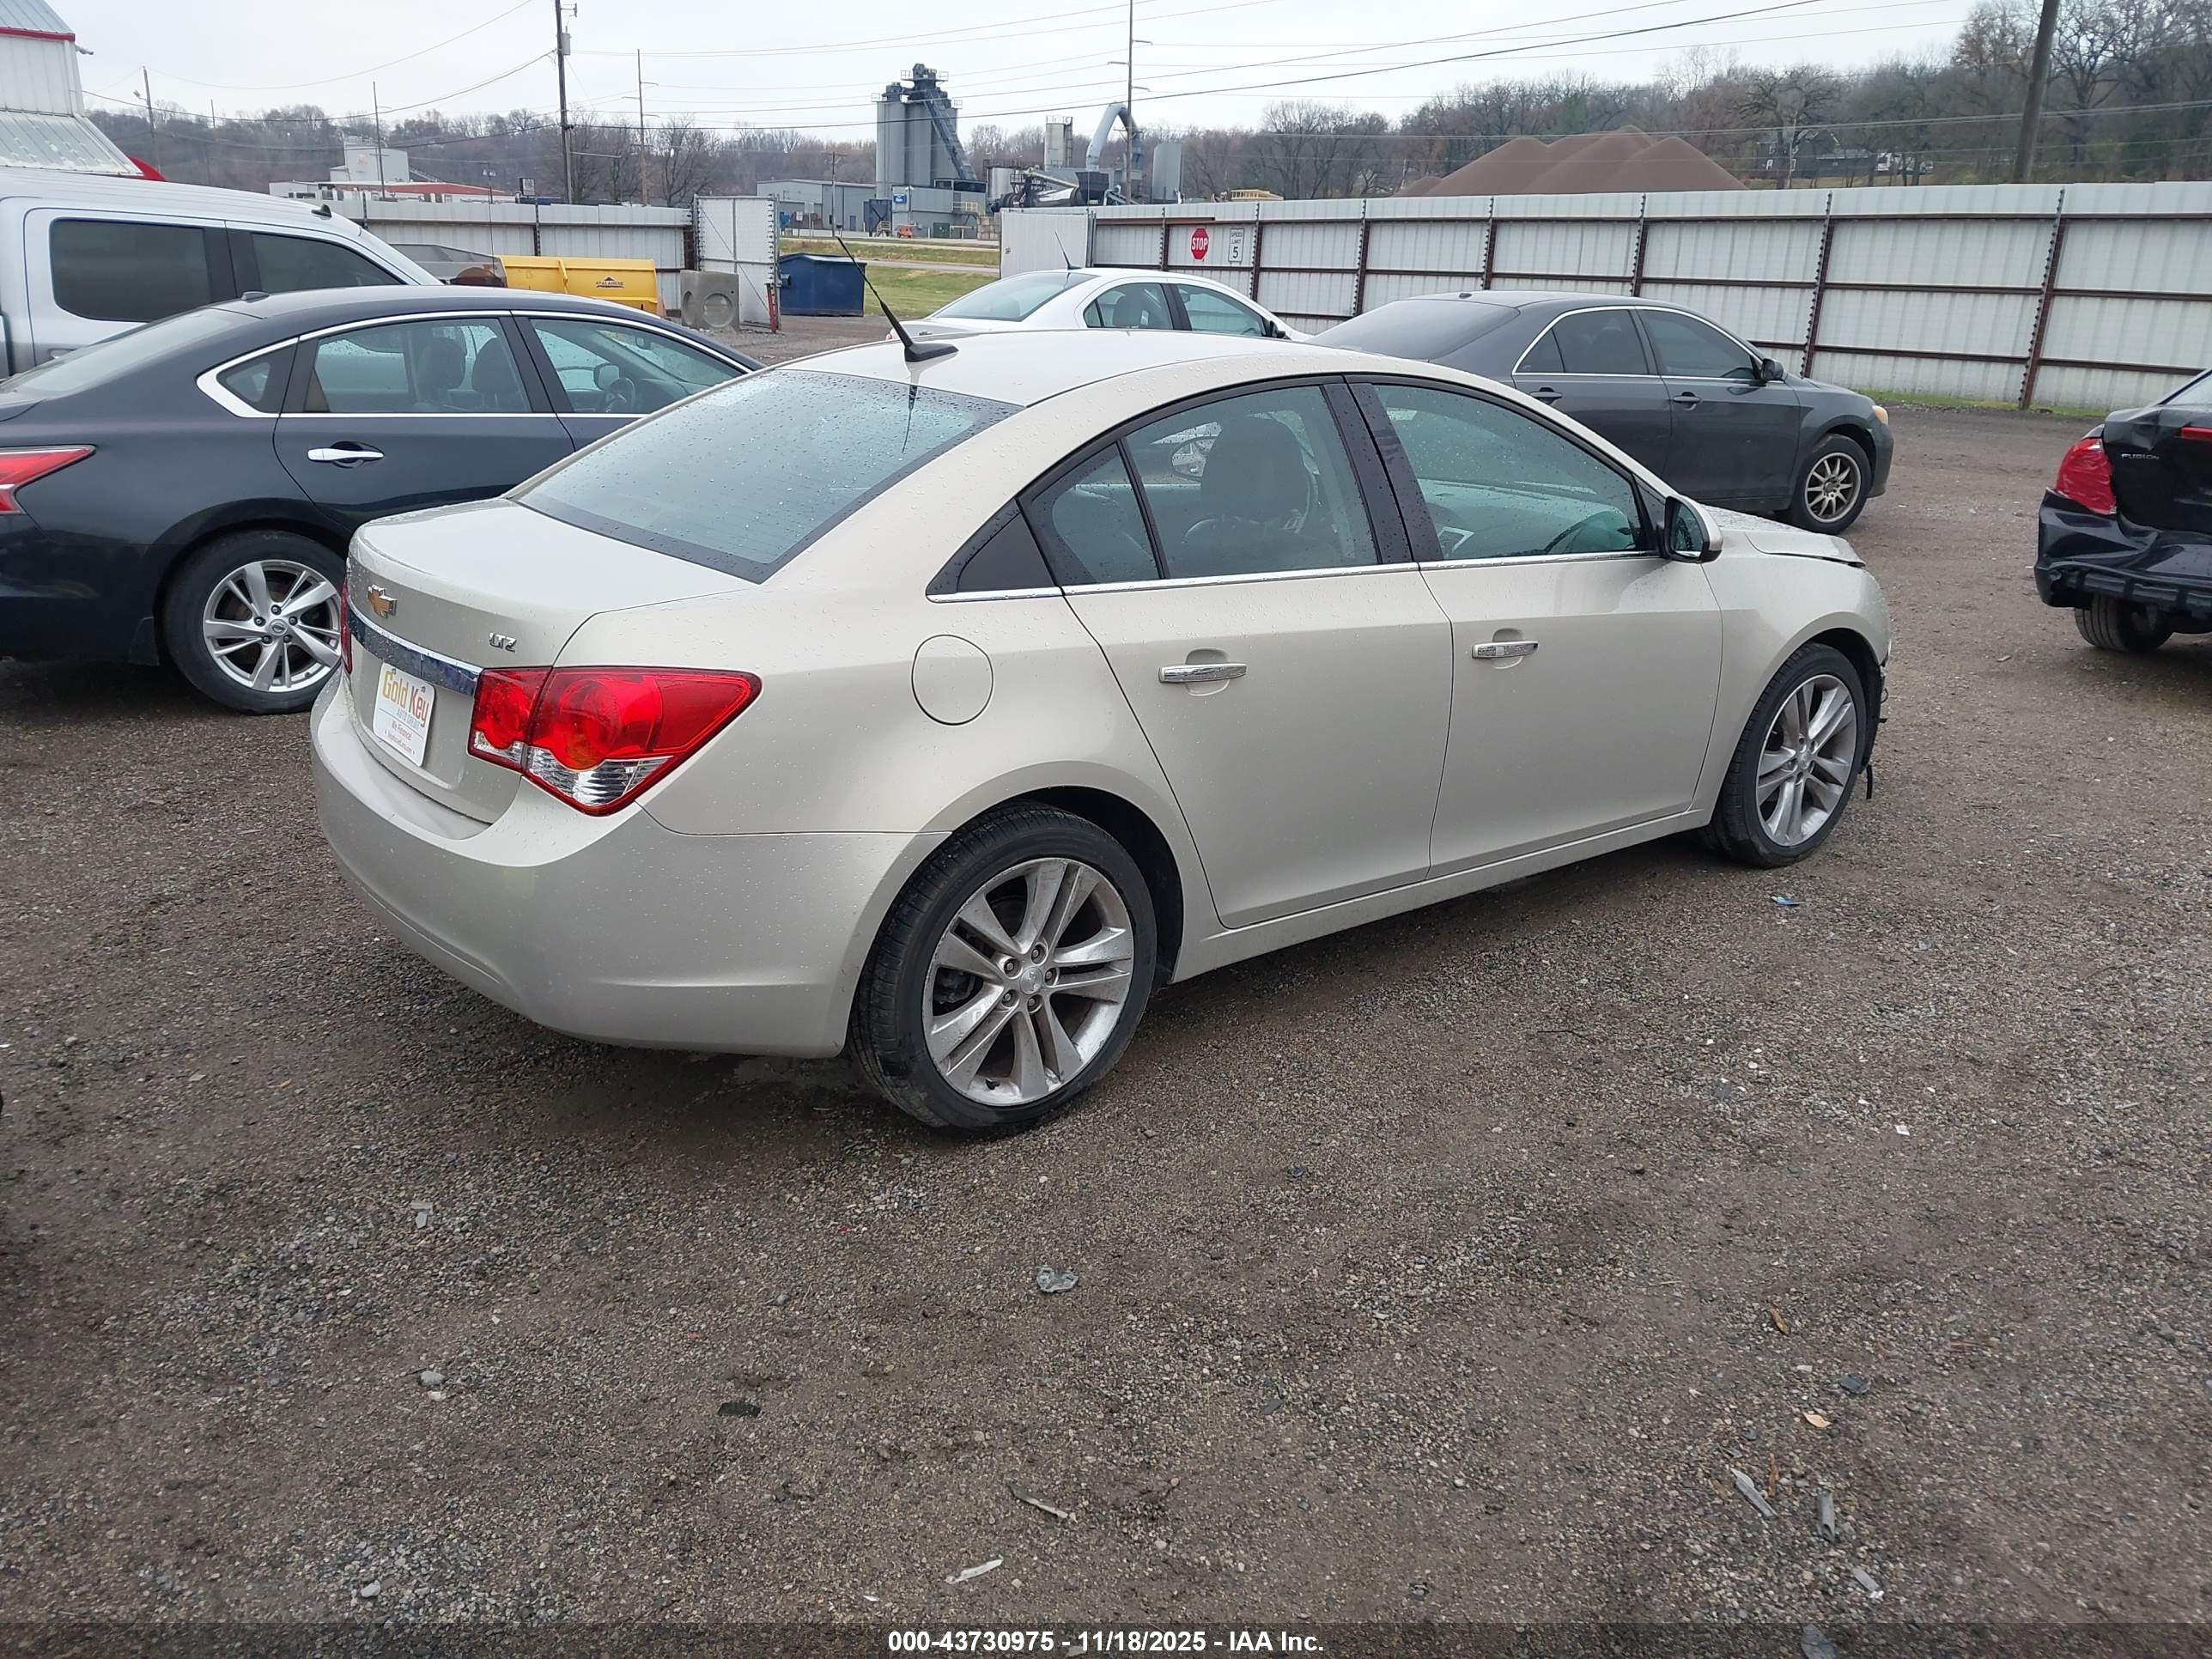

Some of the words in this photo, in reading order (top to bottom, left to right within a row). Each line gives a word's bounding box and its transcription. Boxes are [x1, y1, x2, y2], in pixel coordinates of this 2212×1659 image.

[1192, 238, 1208, 250] STOP
[1232, 246, 1238, 258] 5
[489, 632, 517, 653] LTZ
[383, 671, 409, 708] Gold
[409, 685, 429, 728] Key
